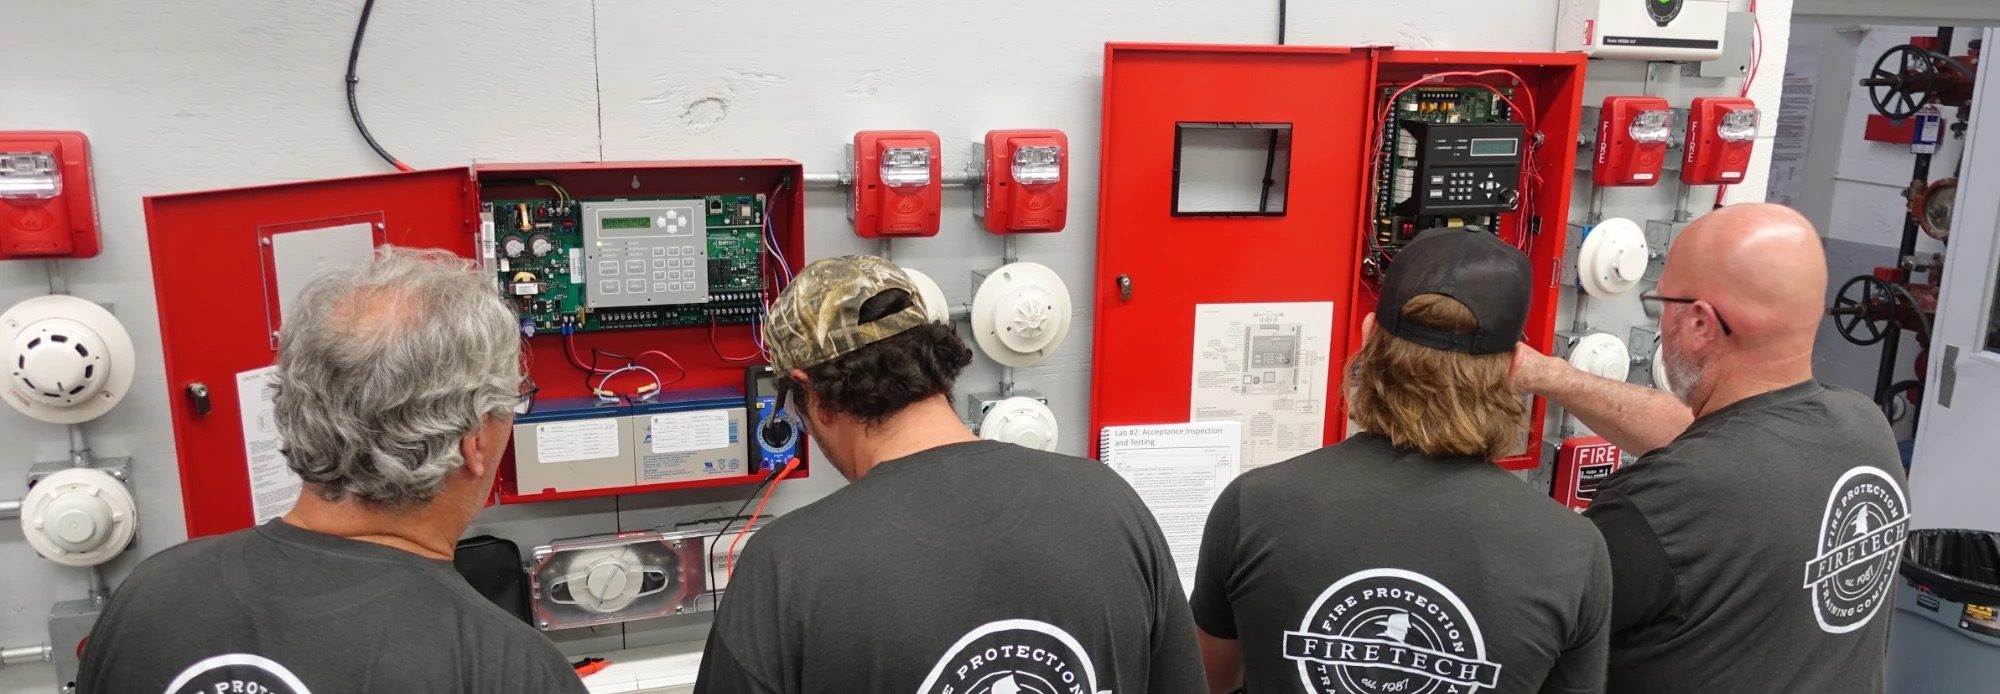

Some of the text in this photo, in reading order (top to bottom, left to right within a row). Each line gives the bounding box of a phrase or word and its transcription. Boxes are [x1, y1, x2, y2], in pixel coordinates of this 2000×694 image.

[1599, 121, 1609, 164] FIRE
[1688, 121, 1699, 163] FIRE
[1115, 429, 1127, 437] Lab
[1142, 428, 1184, 437] Acceptance
[1185, 427, 1223, 436] Inspection
[1130, 439, 1155, 447] Testing
[1579, 445, 1617, 465] FIRE
[1827, 483, 1899, 548] FIRE PROTECTION
[1817, 523, 1905, 578] FIRETECH
[1822, 550, 1896, 617] TRAINING COMPANY
[1856, 564, 1874, 586] 1987
[1322, 587, 1465, 653] FIRE PROTECTION
[957, 645, 1083, 694] PROTECTION
[1302, 638, 1480, 680] FIRETECH
[1381, 678, 1410, 693] 1987
